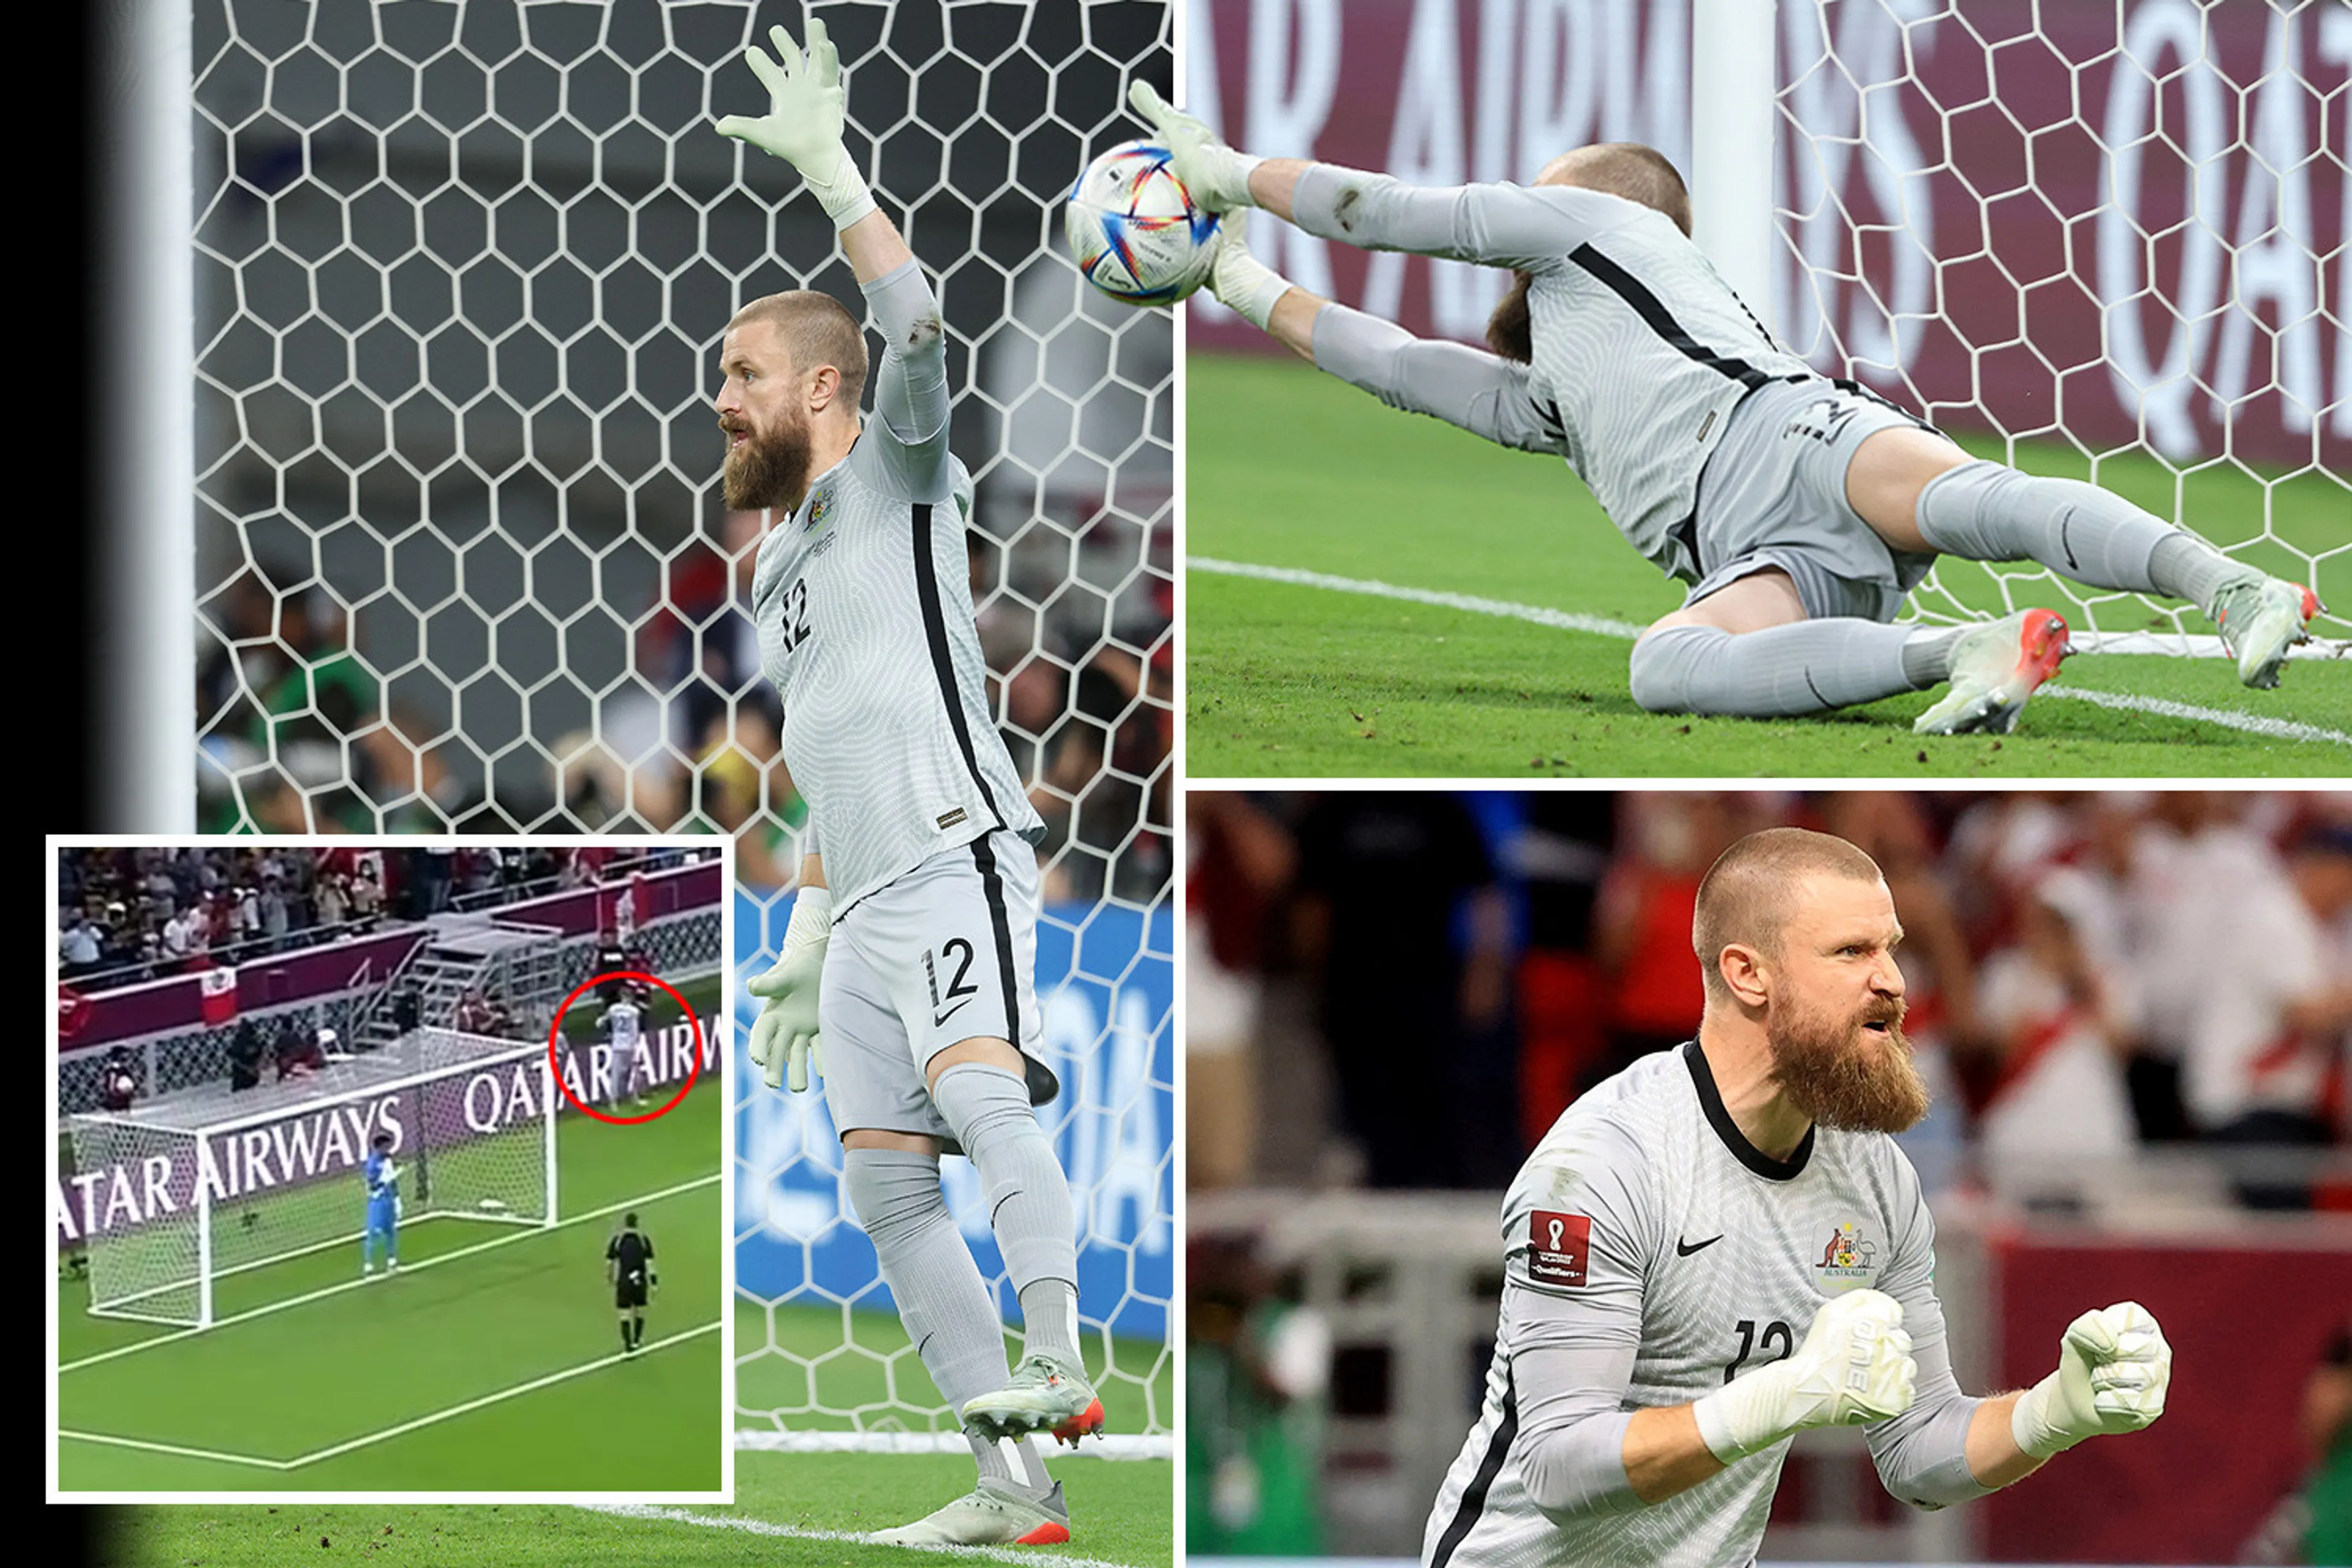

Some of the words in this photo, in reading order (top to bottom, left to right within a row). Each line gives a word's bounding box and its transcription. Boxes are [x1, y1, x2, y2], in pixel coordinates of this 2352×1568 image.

[782, 578, 812, 654] 12
[921, 938, 979, 1008] 12
[190, 1096, 404, 1204] AIRWAYS
